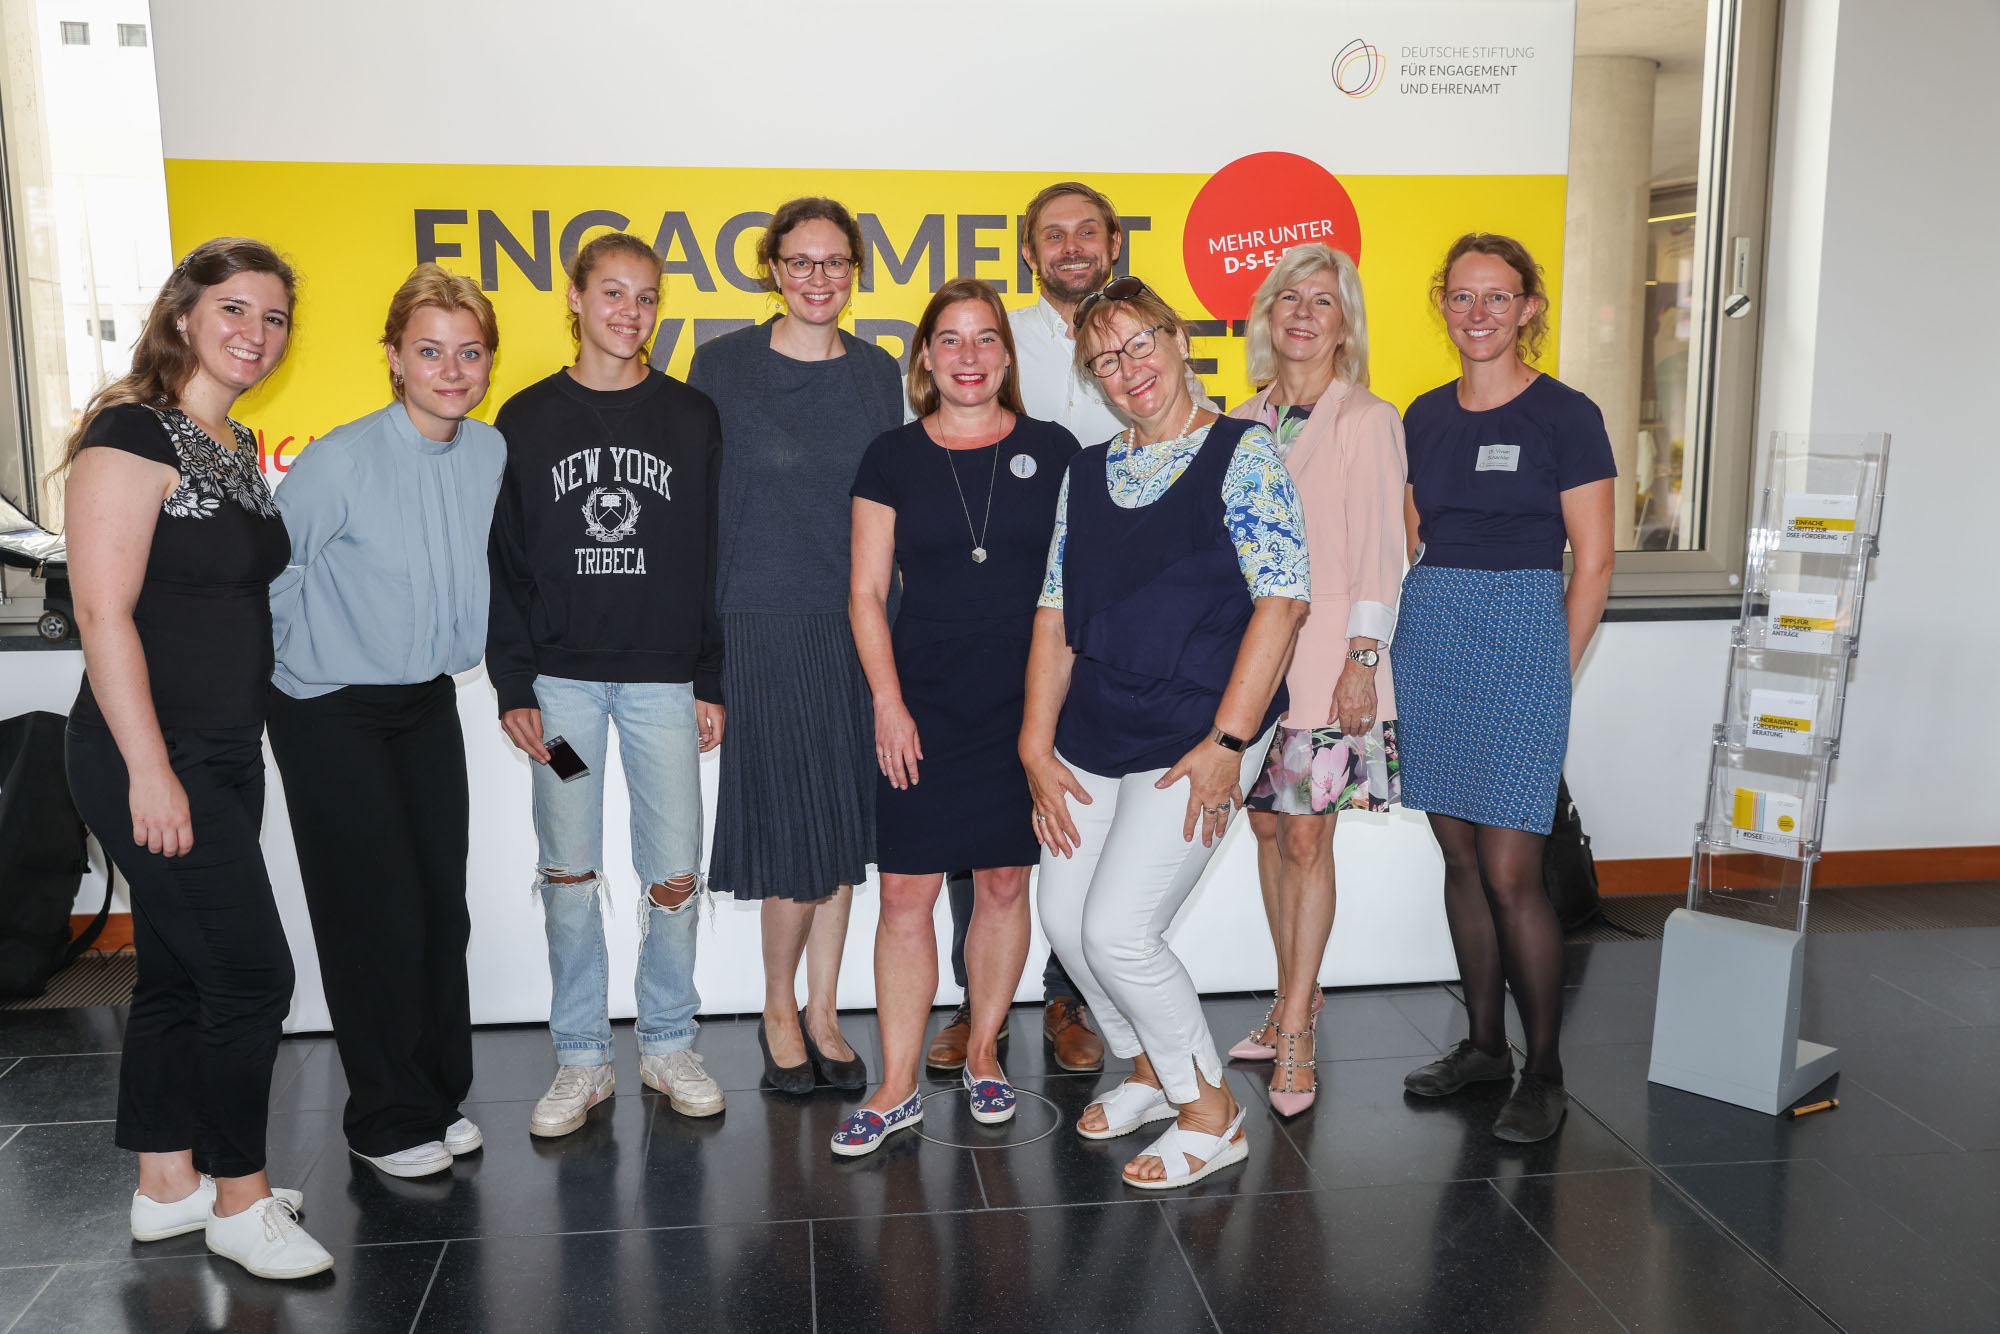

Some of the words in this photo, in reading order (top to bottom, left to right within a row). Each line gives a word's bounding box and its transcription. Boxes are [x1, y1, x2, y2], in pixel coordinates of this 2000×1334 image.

[1401, 46, 1469, 58] DEUTSCHE
[1472, 46, 1535, 58] STIFTUNG
[1400, 62, 1426, 76] FÜR
[1429, 64, 1518, 77] ENGAGEMENT
[1400, 83, 1428, 95] UND
[1431, 83, 1501, 95] EHRENAMT
[1208, 230, 1266, 254] MEHR
[1269, 219, 1334, 244] UNTER
[413, 208, 1152, 294] ENGAGMET
[551, 447, 601, 502] NEW
[609, 447, 673, 501] YORK
[574, 548, 646, 574] TRIBECA
[1753, 716, 1793, 726] FUNDRAISING
[1752, 730, 1783, 738] BERATUNG
